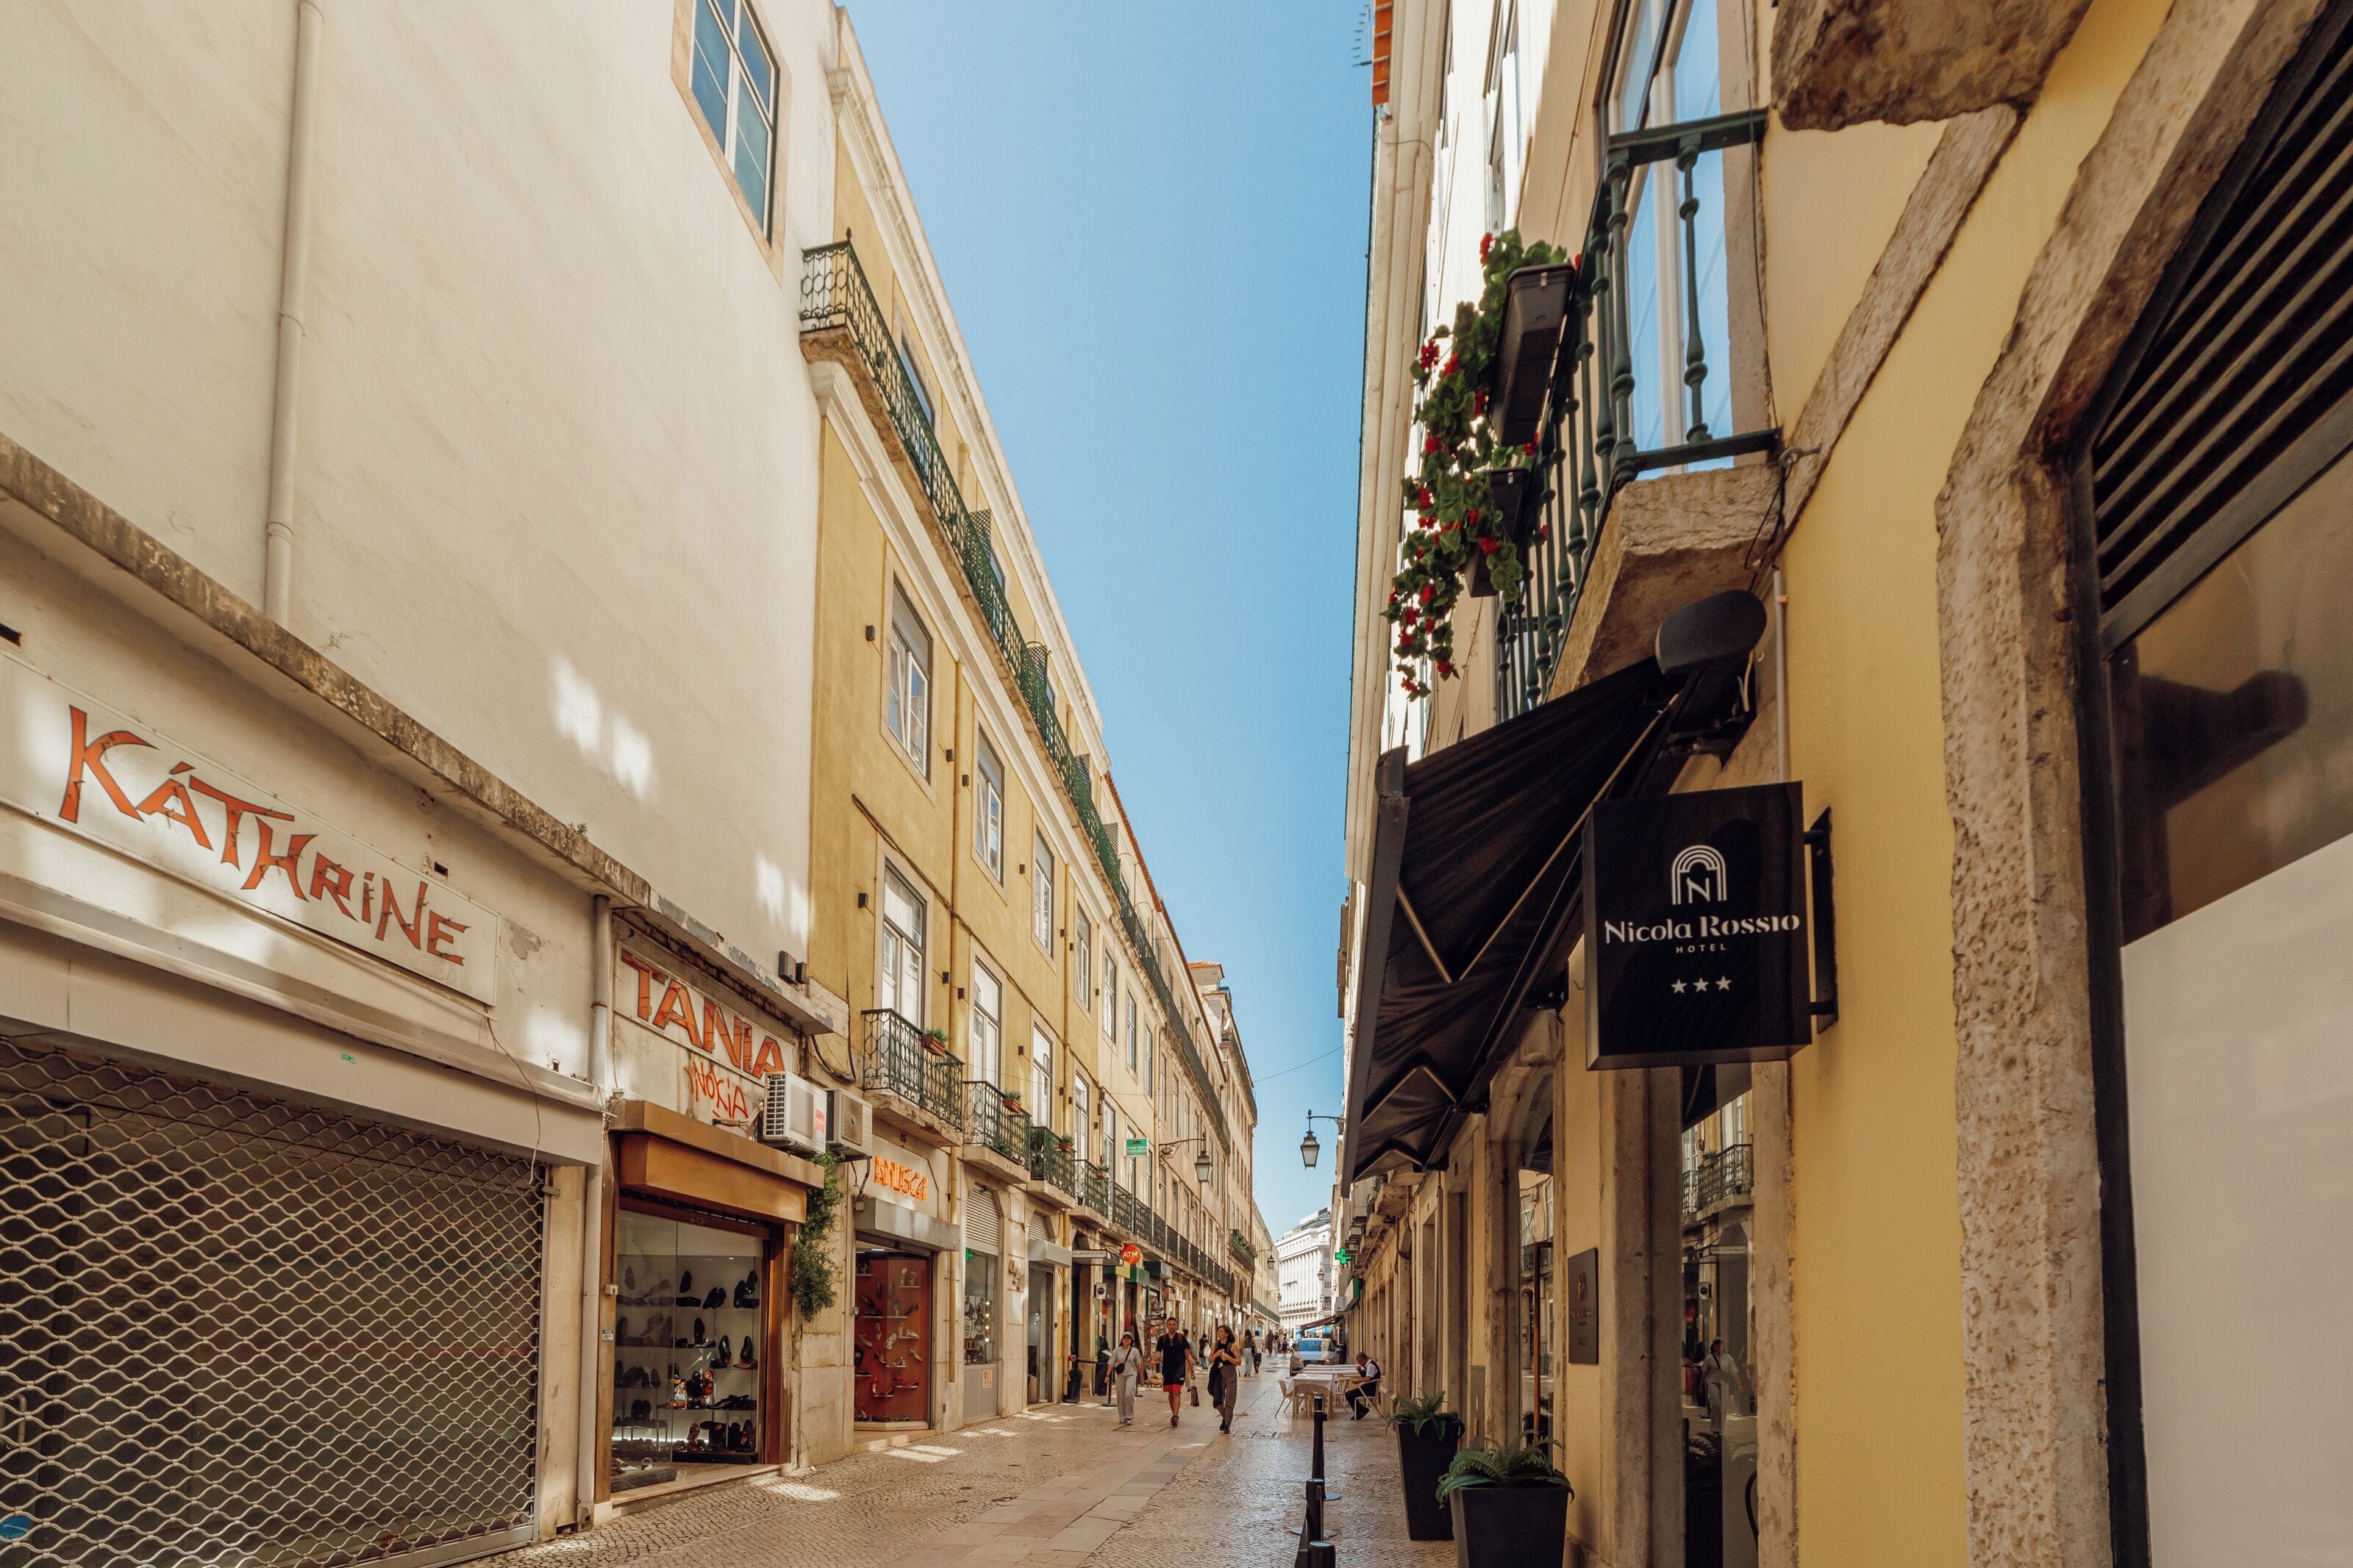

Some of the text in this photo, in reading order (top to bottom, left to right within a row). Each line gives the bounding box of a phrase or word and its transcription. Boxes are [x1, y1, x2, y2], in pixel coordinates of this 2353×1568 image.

[1604, 918, 1693, 944] Nicola
[1676, 943, 1726, 953] HOTEL
[621, 948, 785, 1079] TANIA
